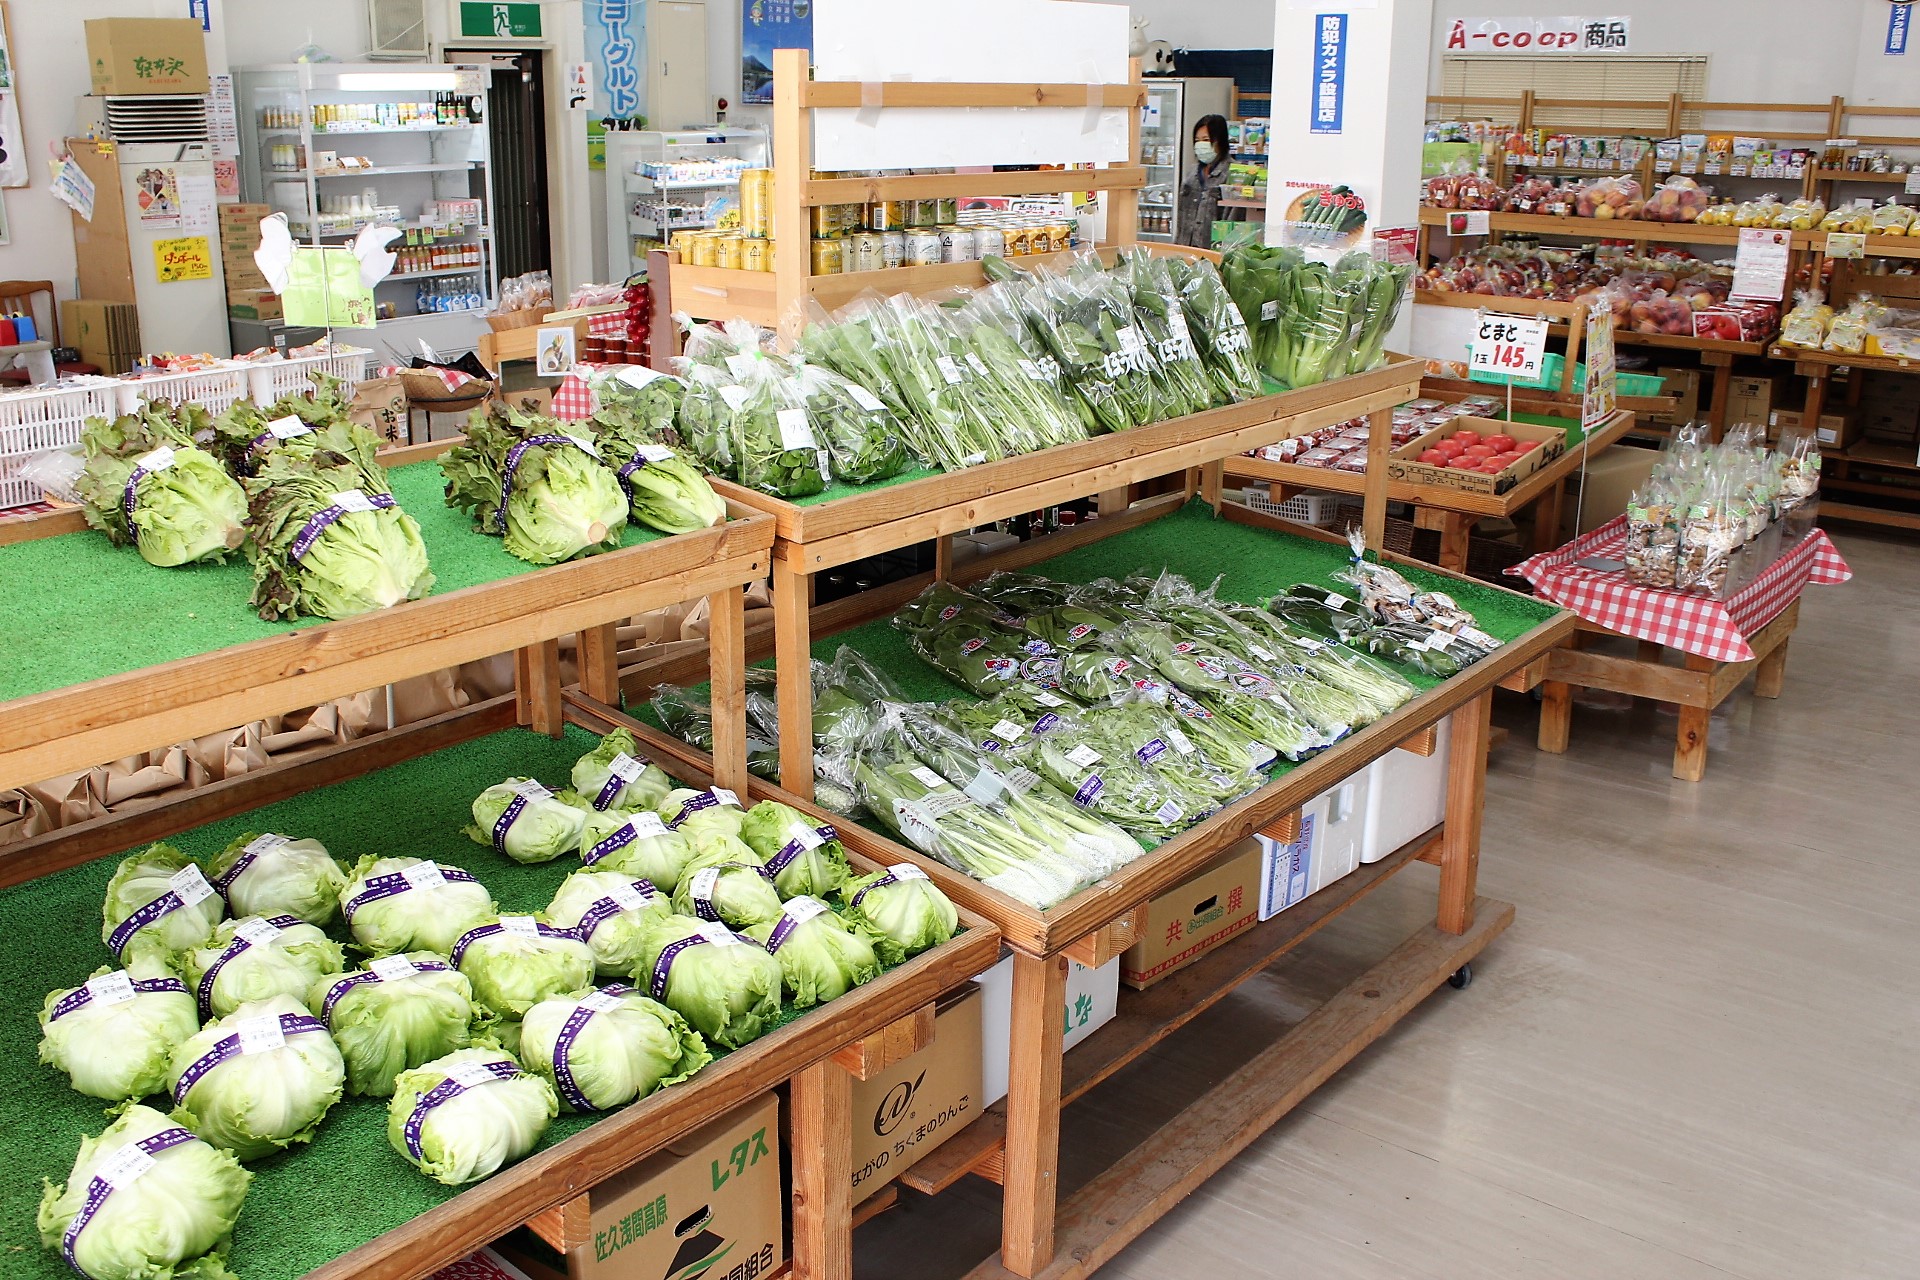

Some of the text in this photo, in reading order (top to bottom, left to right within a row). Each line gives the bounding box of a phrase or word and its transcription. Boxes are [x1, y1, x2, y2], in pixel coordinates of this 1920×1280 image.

[1585, 21, 1627, 49] 商品
[605, 0, 634, 110] ヨーグルト
[1318, 16, 1341, 122] 防犯カメラ設置店
[1319, 190, 1366, 211] きゅうり
[1479, 321, 1518, 343] とまと
[1473, 344, 1534, 370] 1玉 145 円
[382, 408, 398, 443] お米
[1166, 918, 1182, 947] 共
[851, 1094, 969, 1187] ながの ちくまのりんご
[711, 1126, 770, 1192] レタス
[594, 1193, 669, 1263] 佐久浅間高原
[719, 1242, 775, 1280] 同組合
